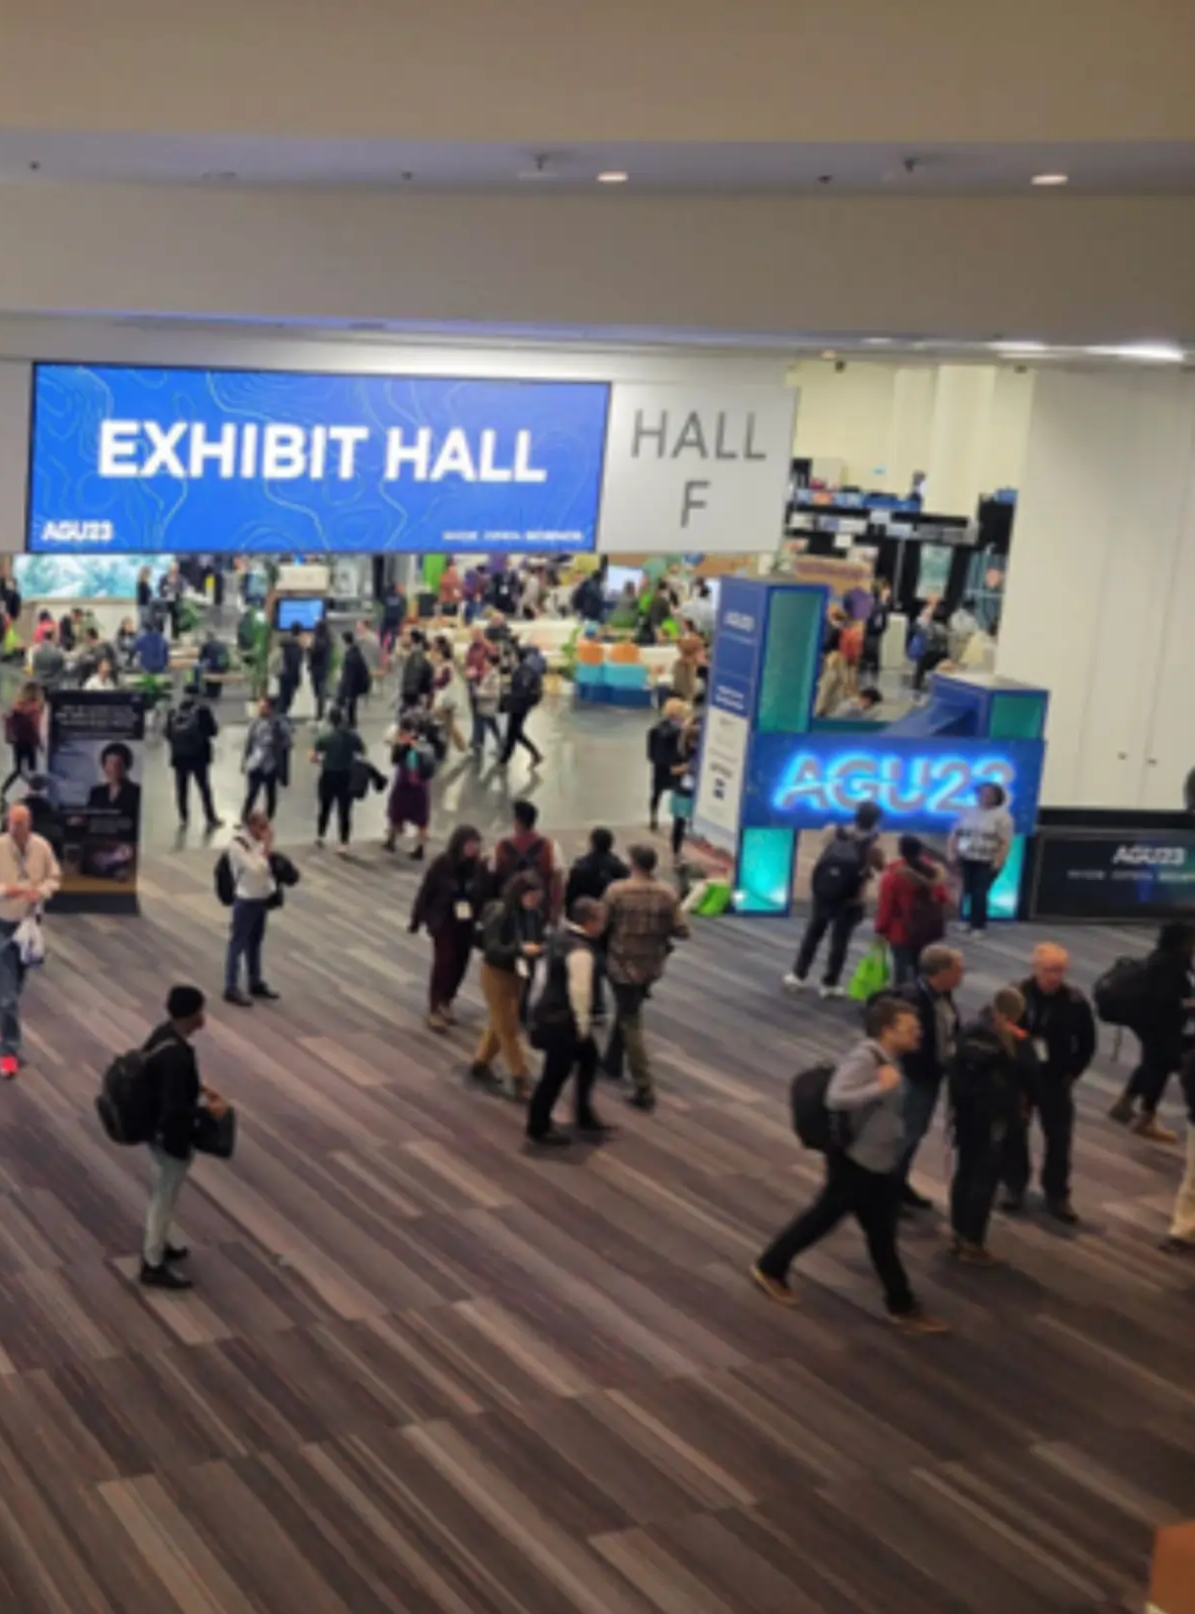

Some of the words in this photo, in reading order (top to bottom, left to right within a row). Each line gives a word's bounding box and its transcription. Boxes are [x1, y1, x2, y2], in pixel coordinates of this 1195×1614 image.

[98, 419, 368, 480] EXHIBIT
[384, 426, 547, 483] HALL
[631, 409, 767, 462] HALL
[680, 480, 711, 528] F
[775, 756, 1015, 814] AGU23
